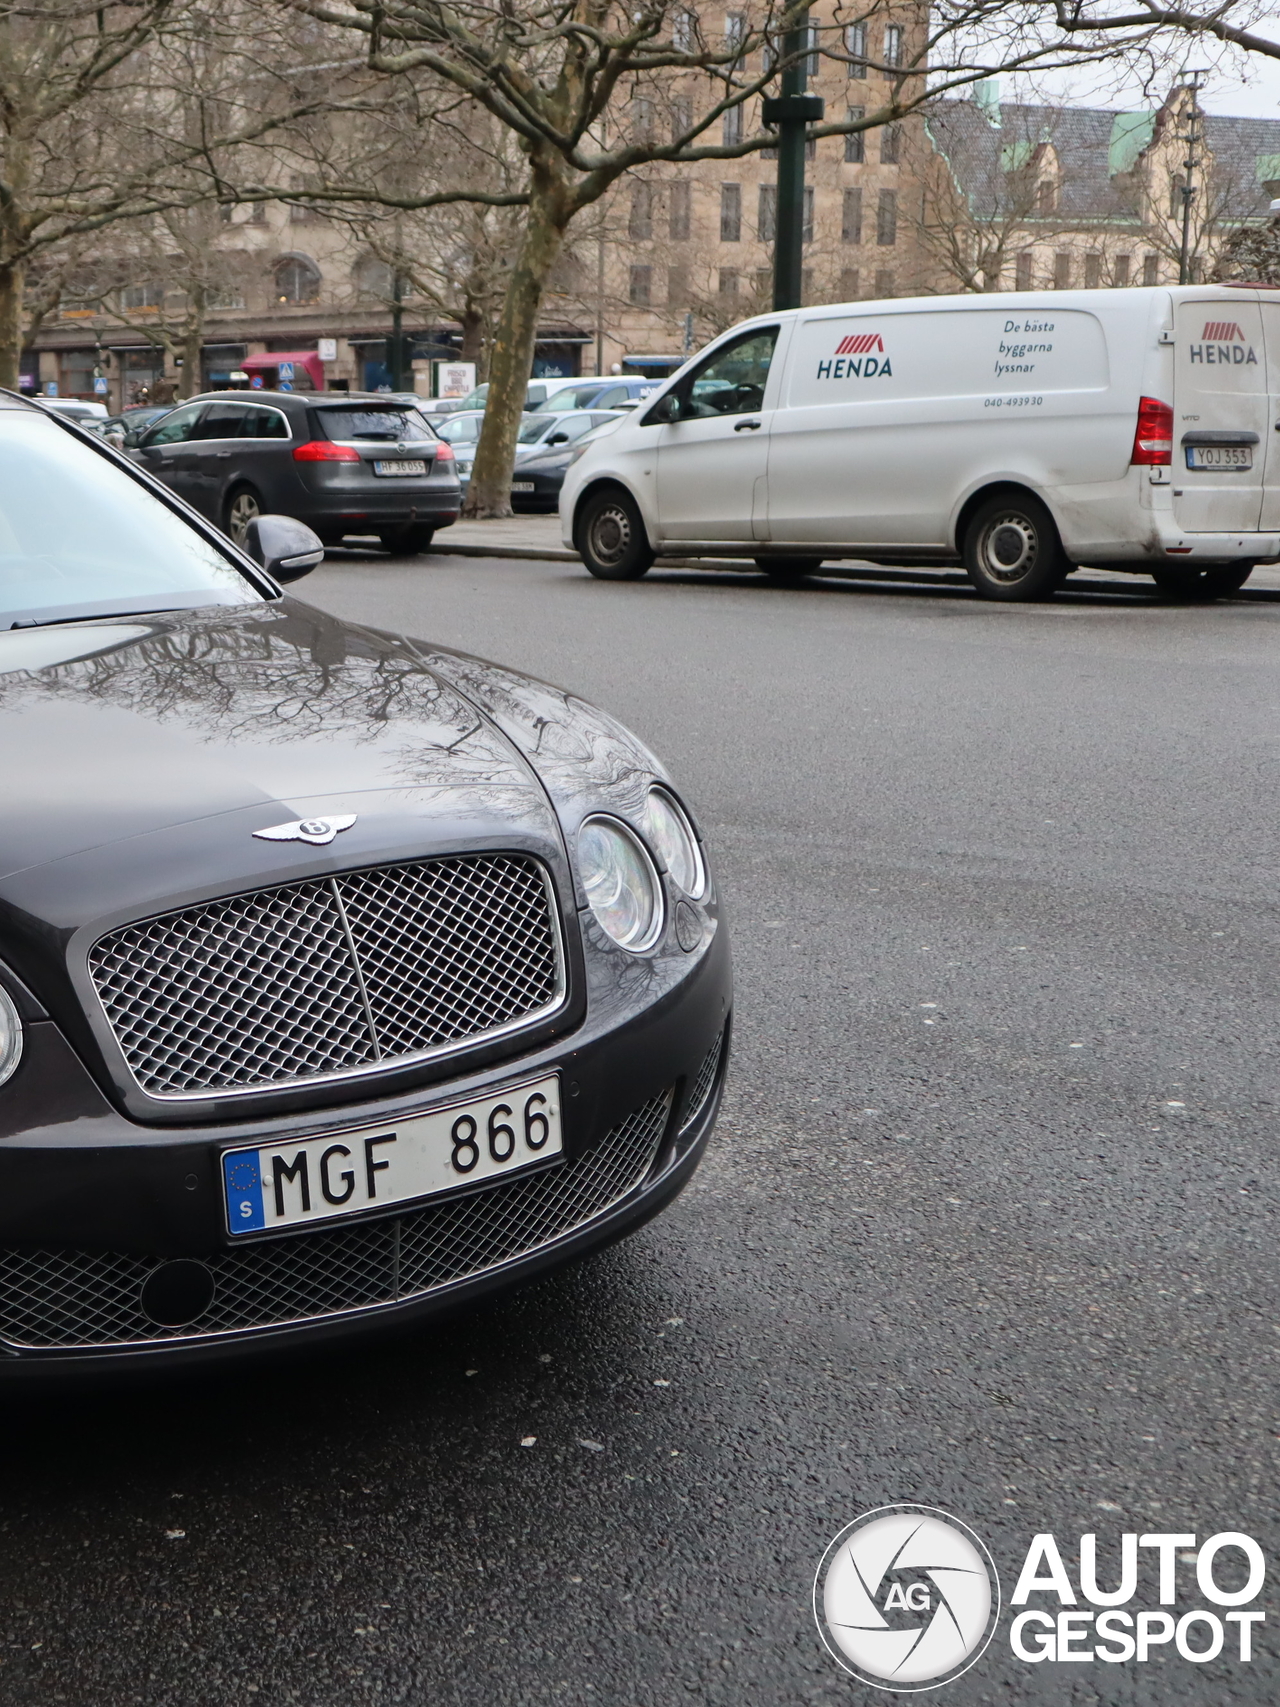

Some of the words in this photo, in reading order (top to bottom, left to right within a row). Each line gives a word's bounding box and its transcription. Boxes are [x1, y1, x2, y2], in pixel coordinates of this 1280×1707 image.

[1003, 320, 1021, 333] De
[1024, 319, 1055, 333] bästa
[998, 340, 1053, 358] byggarna
[1190, 344, 1258, 365] HENDA
[816, 357, 893, 379] HENDA
[994, 361, 1035, 378] lyssnar
[984, 396, 1043, 408] 040-493930
[1198, 449, 1221, 464] YOJ
[1225, 449, 1248, 465] 353
[272, 1132, 397, 1216] MGF
[451, 1092, 550, 1173] 866
[239, 1200, 253, 1218] S
